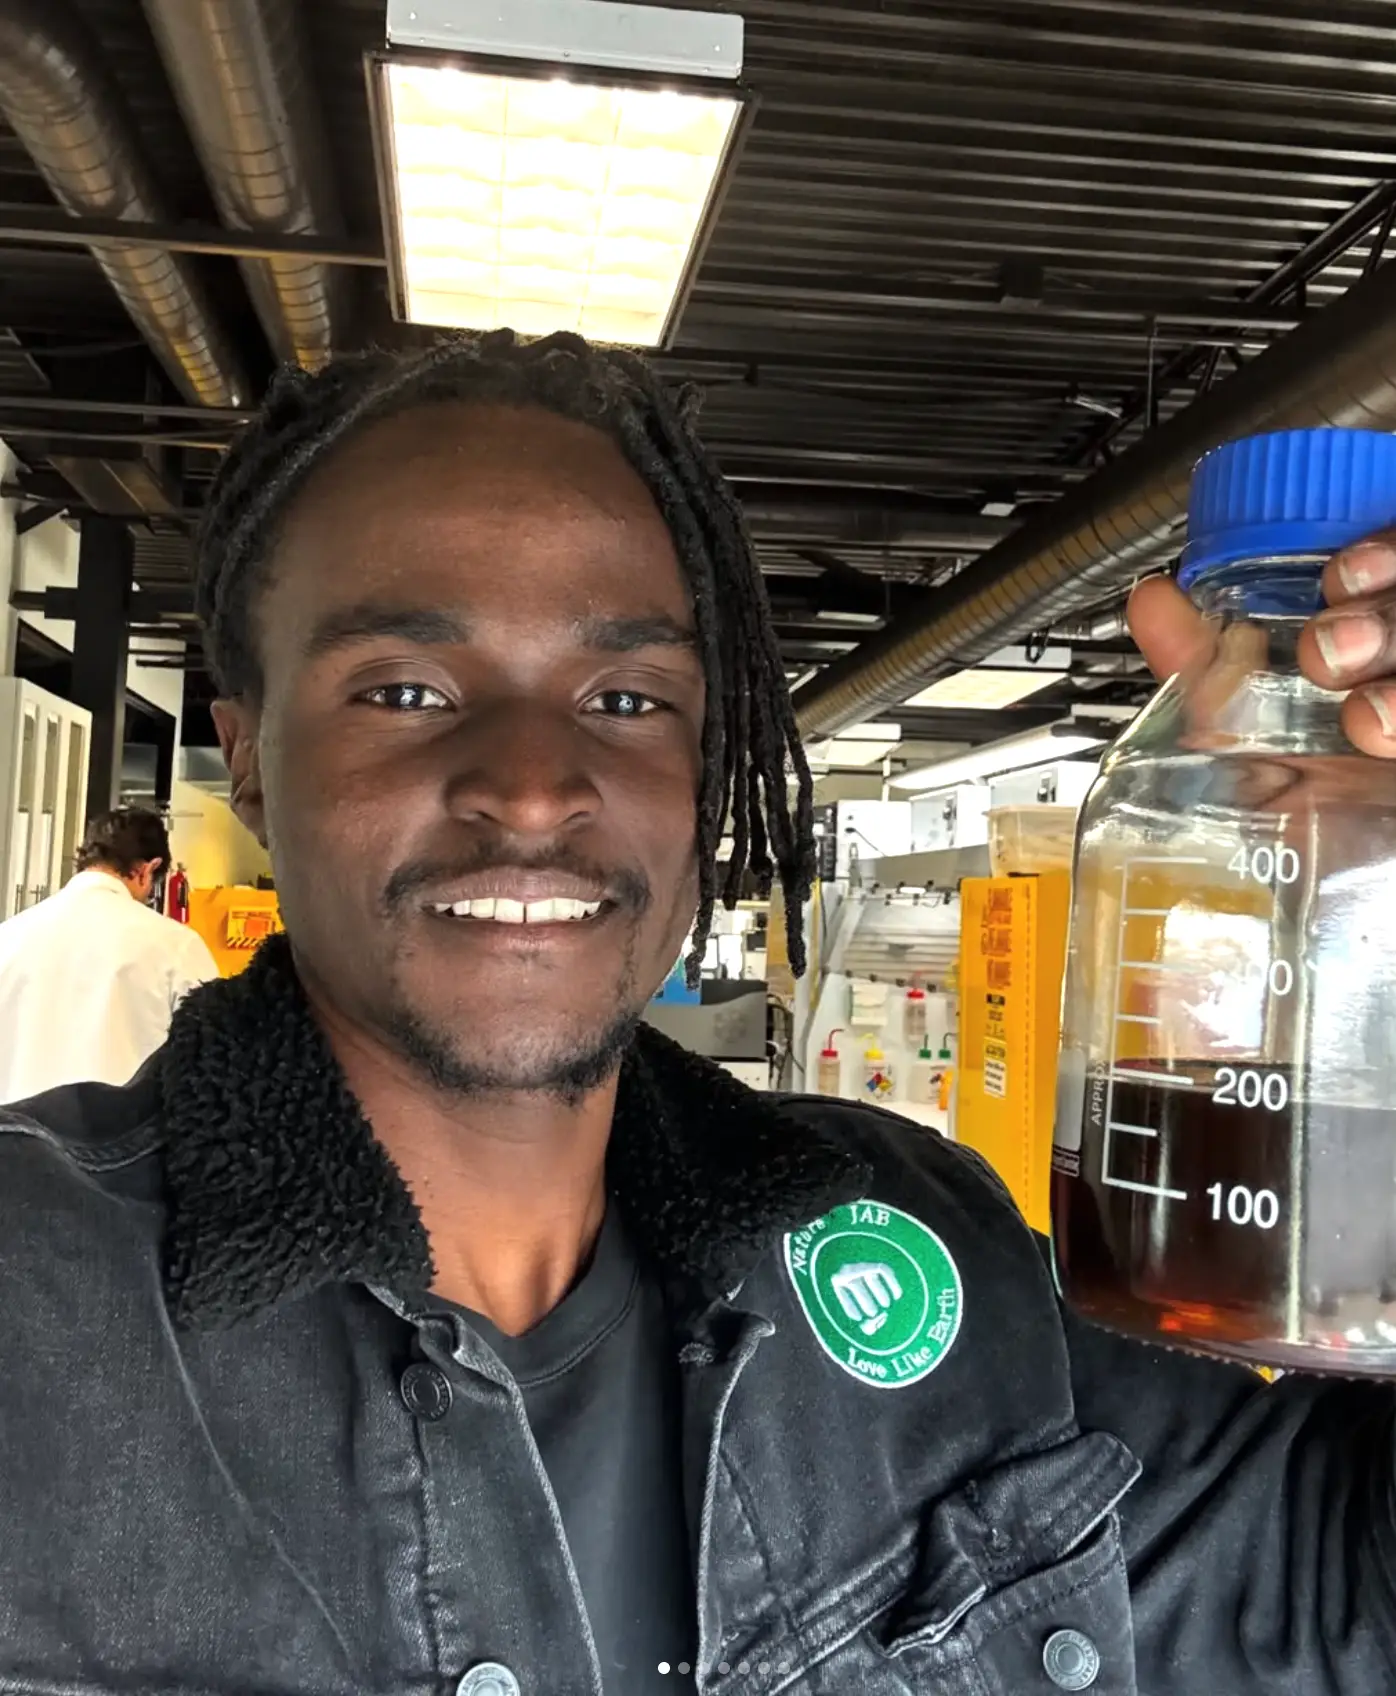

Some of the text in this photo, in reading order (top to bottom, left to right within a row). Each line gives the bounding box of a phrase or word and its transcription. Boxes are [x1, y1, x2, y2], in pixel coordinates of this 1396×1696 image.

[1228, 846, 1300, 884] 400
[1213, 1067, 1289, 1112] 200
[850, 1205, 889, 1227] JAB
[1206, 1182, 1280, 1230] 100
[849, 1288, 956, 1378] Love Like Earth
